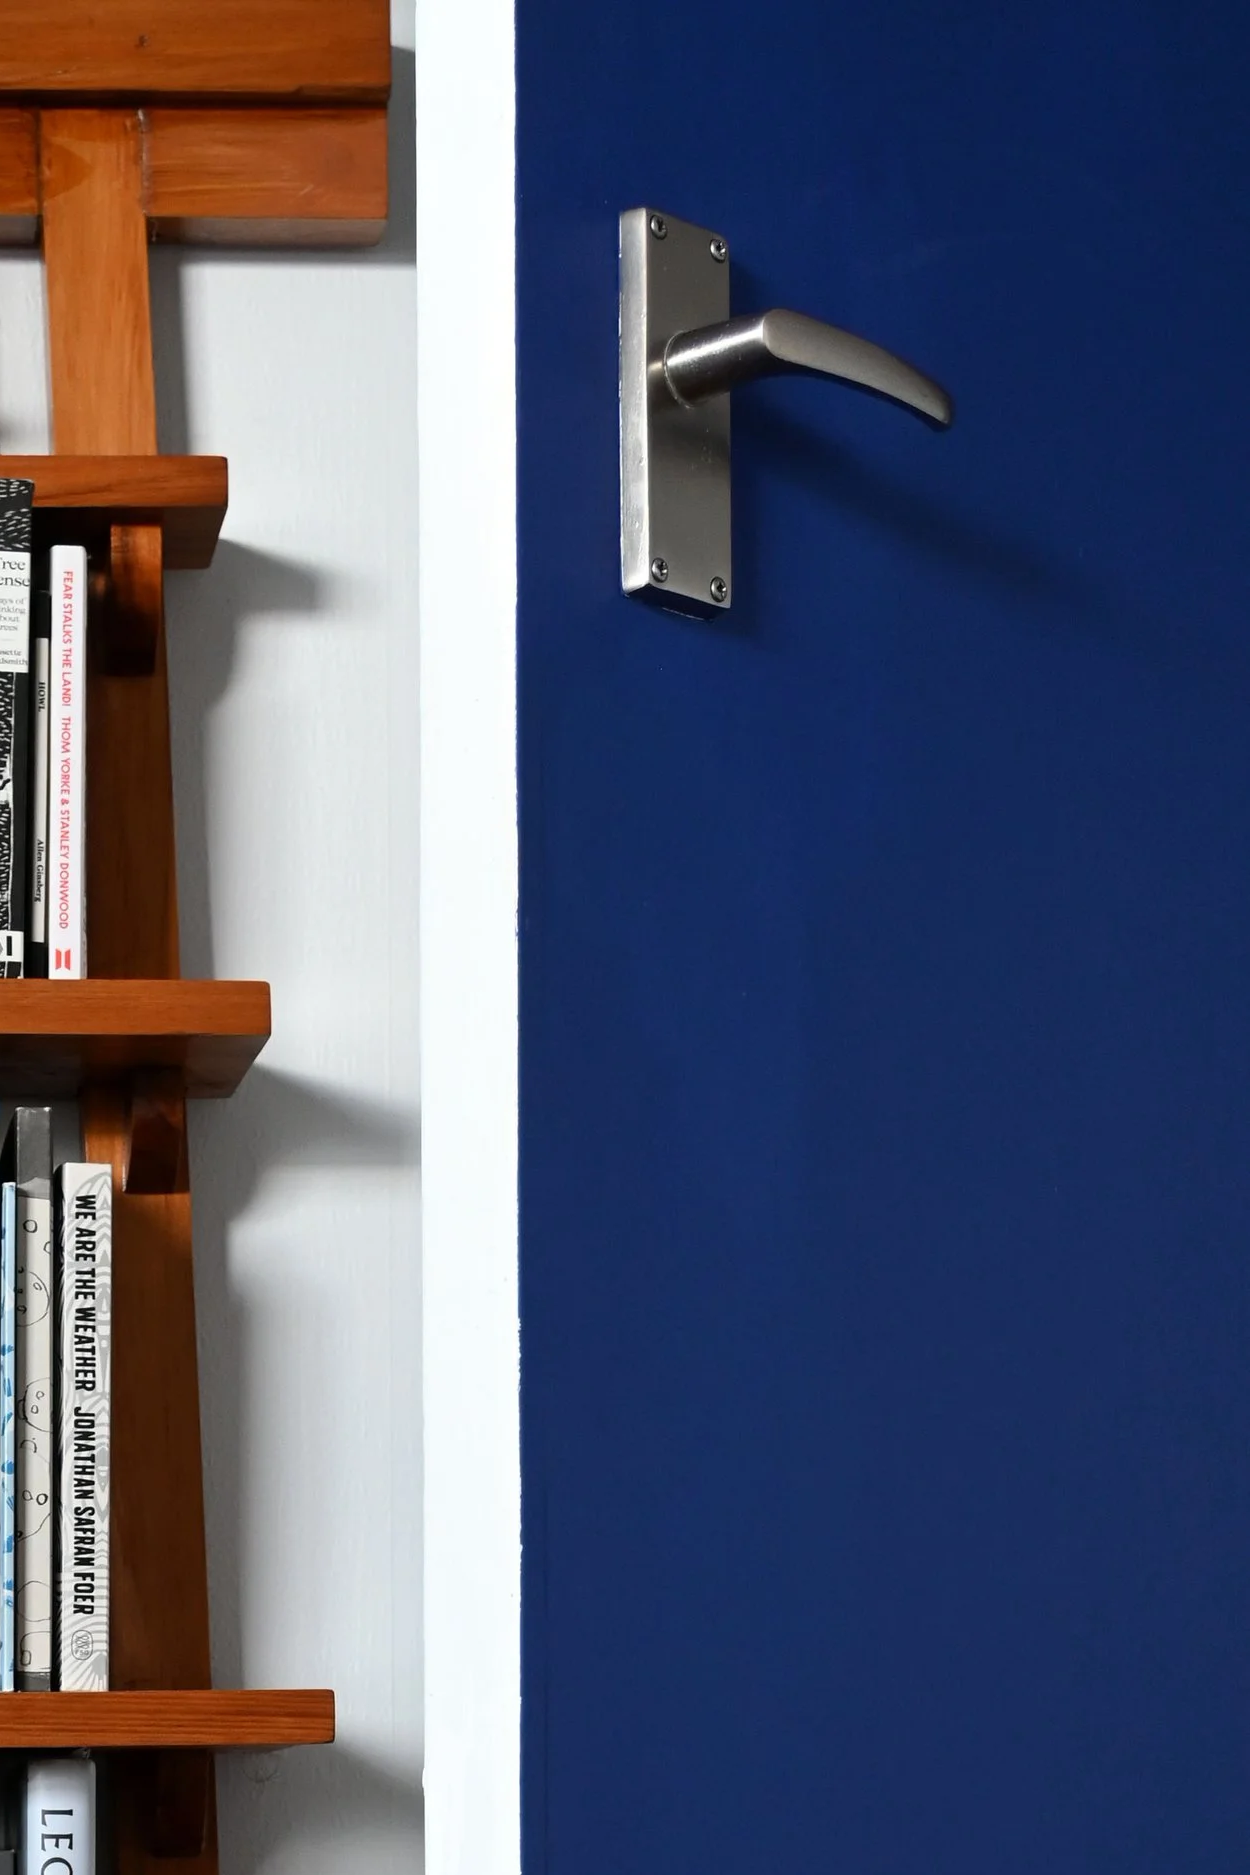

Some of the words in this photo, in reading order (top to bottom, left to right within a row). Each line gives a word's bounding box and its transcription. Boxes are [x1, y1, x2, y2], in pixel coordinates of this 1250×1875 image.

[37, 681, 48, 713] HOWL
[74, 1194, 97, 1221] WE
[74, 1226, 97, 1263] ARE
[74, 1267, 96, 1301] THE
[74, 1306, 97, 1392] WEATHER
[73, 1406, 96, 1500] JONATHAN
[73, 1506, 96, 1567] SAFRAN
[72, 1572, 95, 1615] FOER
